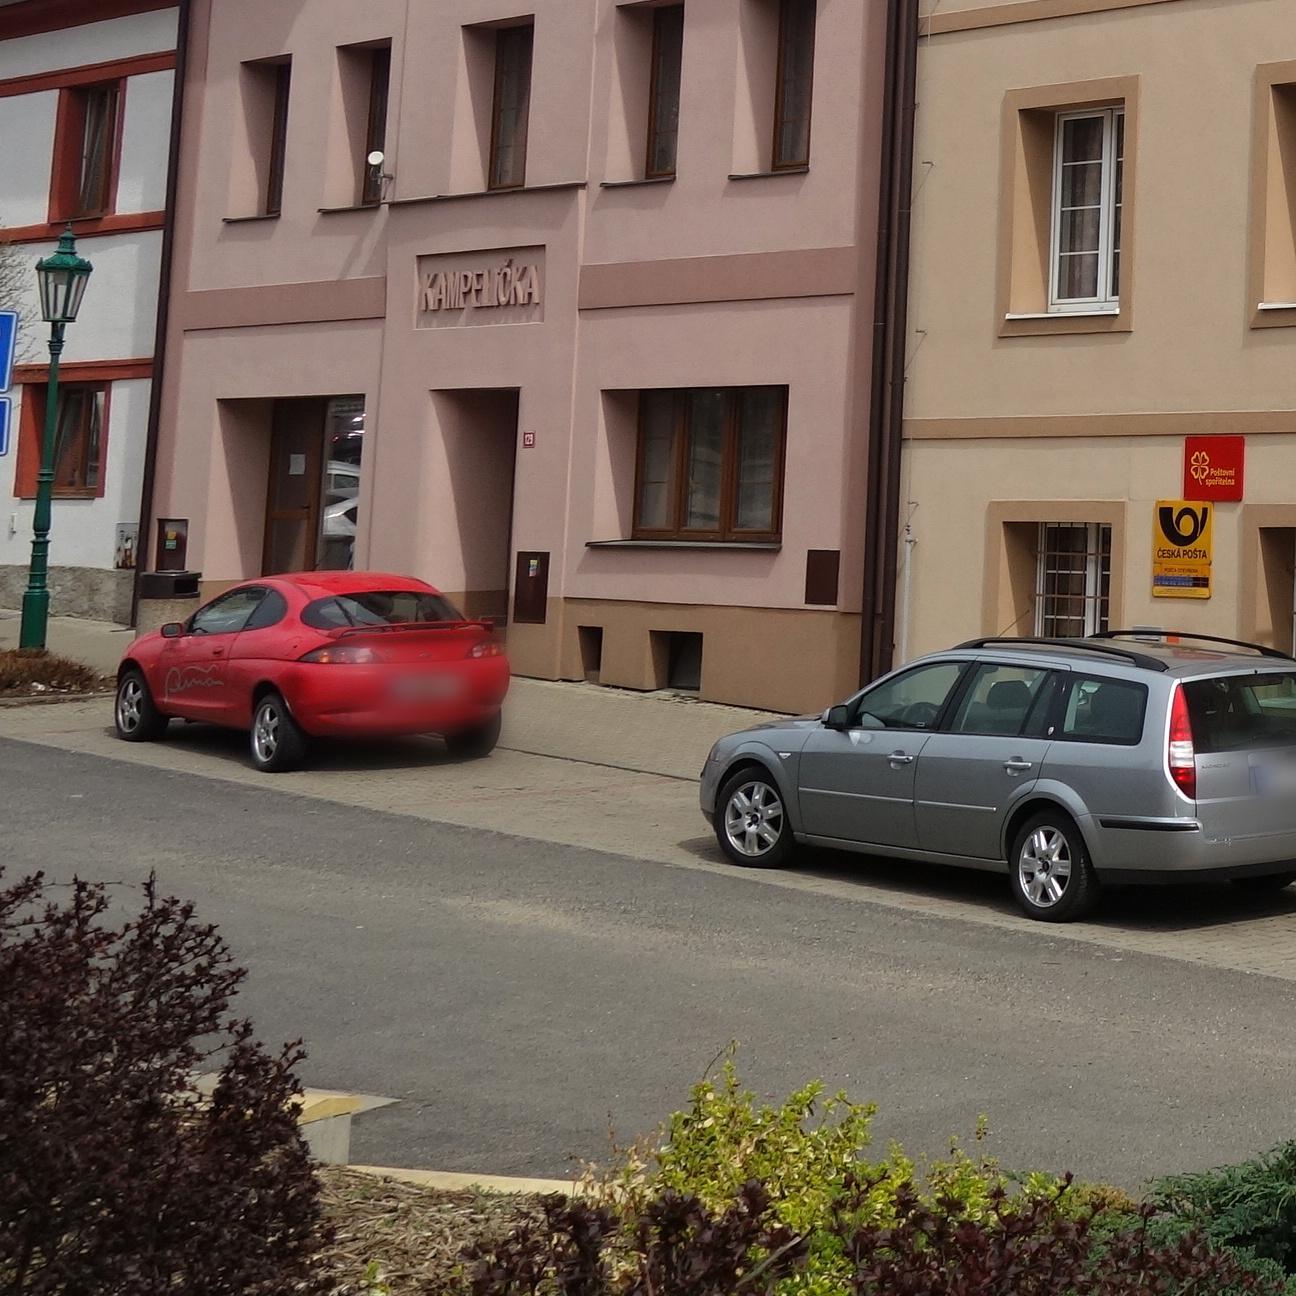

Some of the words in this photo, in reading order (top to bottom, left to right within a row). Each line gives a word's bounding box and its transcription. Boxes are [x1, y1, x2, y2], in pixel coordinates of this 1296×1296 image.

[421, 258, 540, 311] KAMPELIČKA
[1209, 467, 1235, 477] Poštovní
[1205, 477, 1235, 487] spořitelna
[1157, 547, 1181, 559] ČESKÁ
[1182, 548, 1207, 559] POŠTA
